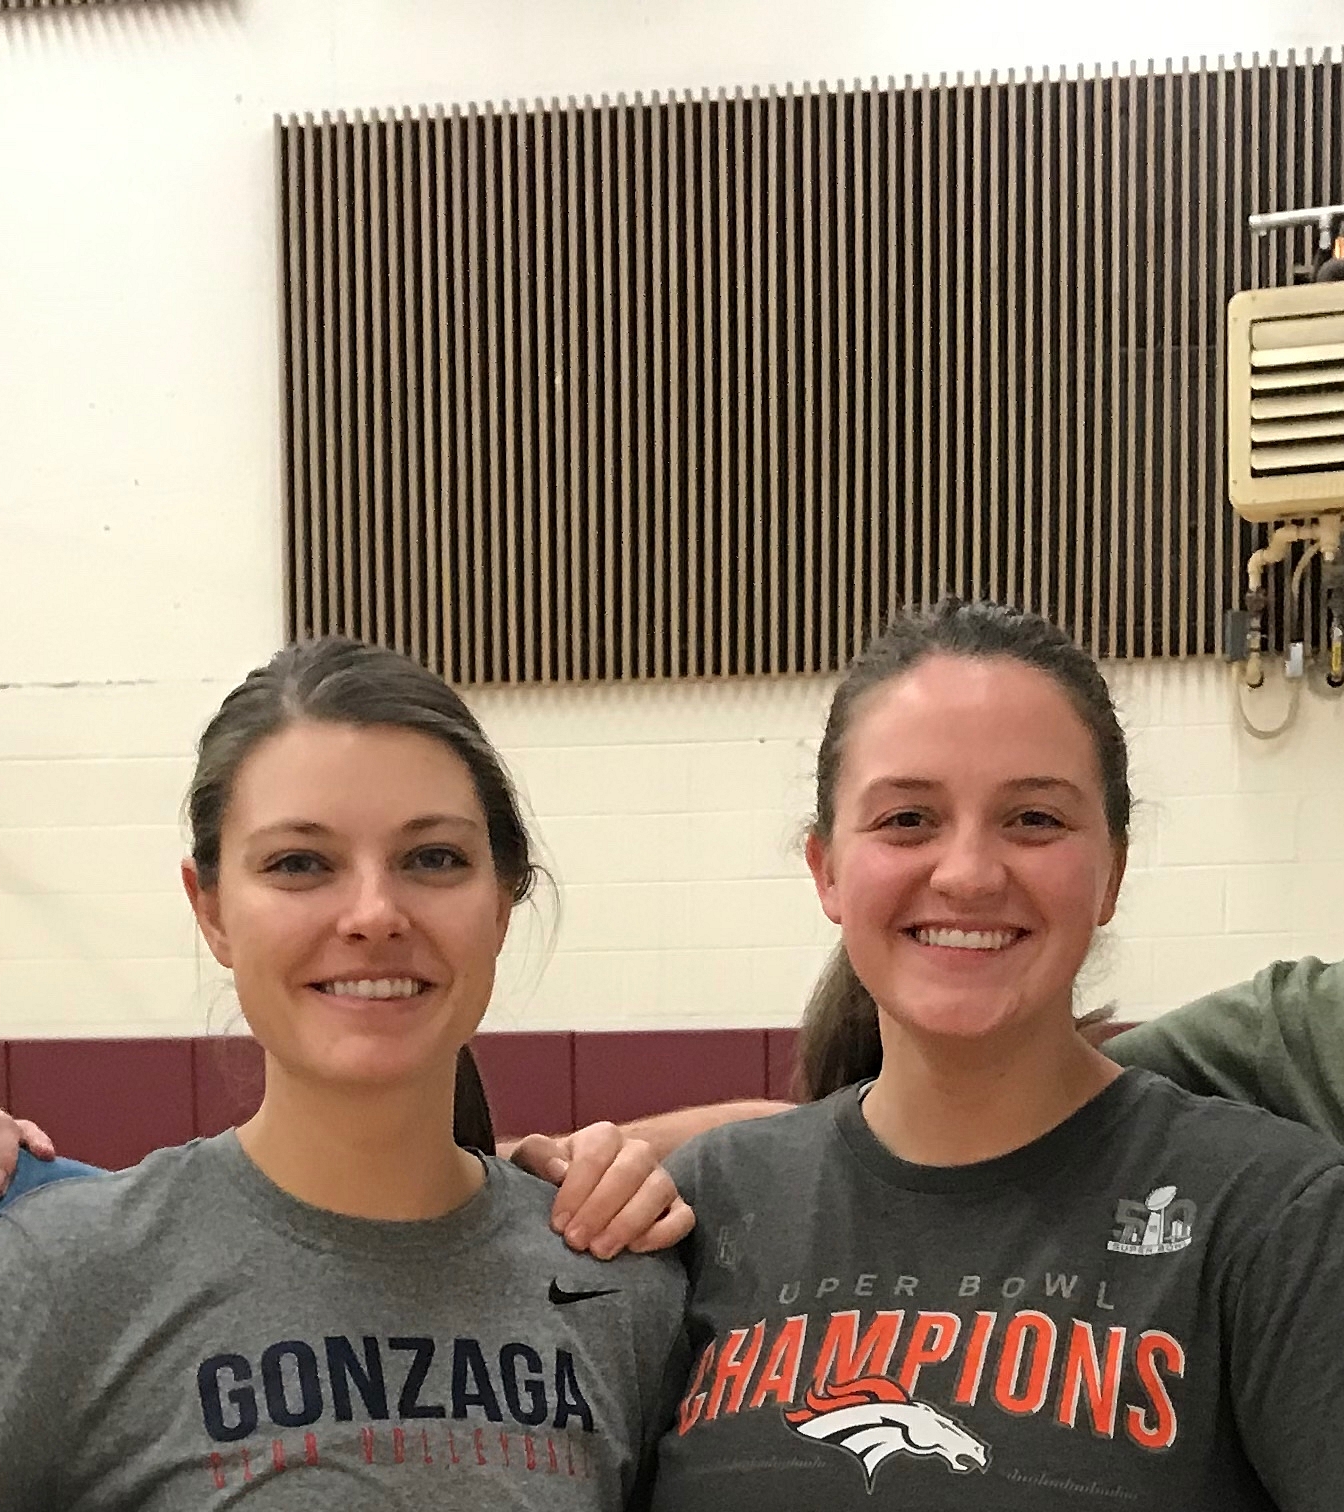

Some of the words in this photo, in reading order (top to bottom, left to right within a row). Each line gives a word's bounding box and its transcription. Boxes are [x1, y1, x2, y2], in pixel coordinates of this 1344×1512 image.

[779, 1273, 920, 1304] UPER
[958, 1271, 1115, 1311] BOWL
[197, 1335, 594, 1442] GONZAGA
[678, 1308, 1185, 1451] CHAMPIONS
